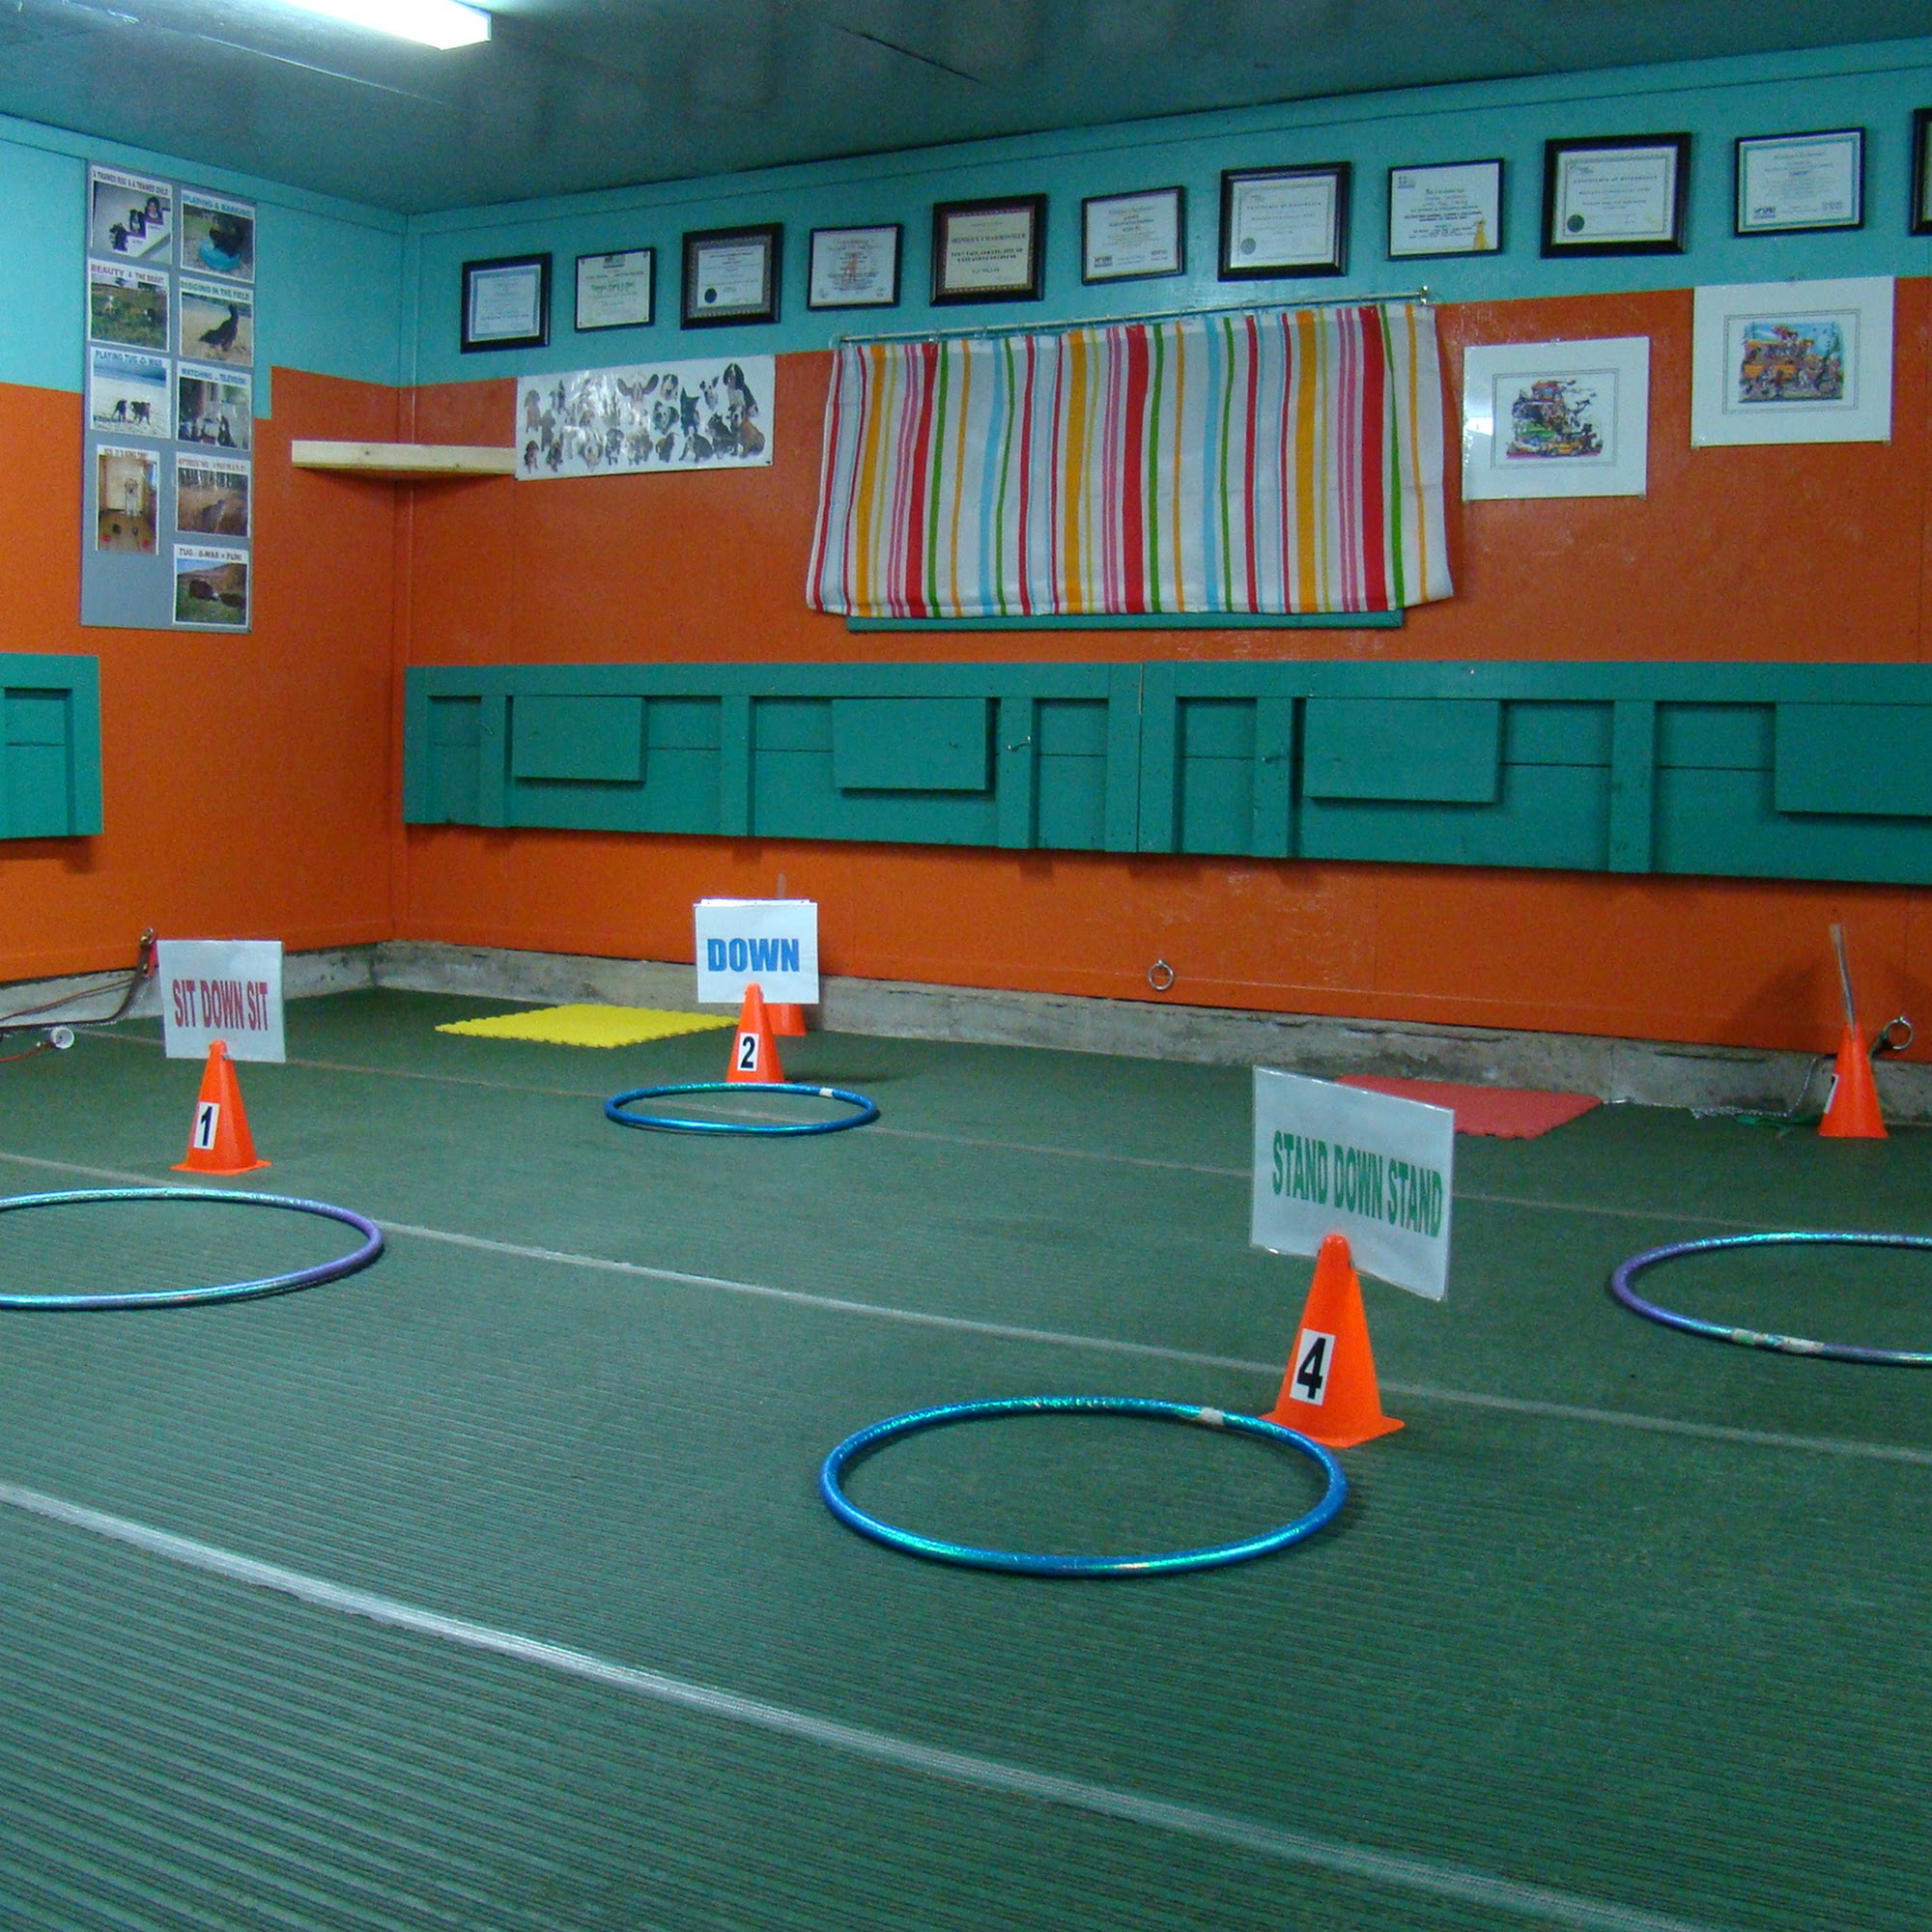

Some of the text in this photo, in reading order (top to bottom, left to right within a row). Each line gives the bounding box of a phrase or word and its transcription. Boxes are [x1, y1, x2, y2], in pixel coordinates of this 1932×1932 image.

[91, 264, 124, 277] BEAUTY
[96, 350, 123, 362] PLAYING
[179, 548, 193, 556] TUG
[707, 938, 800, 973] DOWN
[172, 979, 268, 1032] SIT DOWN SIT
[740, 1036, 755, 1069] 2
[200, 1106, 213, 1147] 1
[1272, 1130, 1442, 1237] STAND DOWN STAND
[1296, 1337, 1325, 1399] 4
